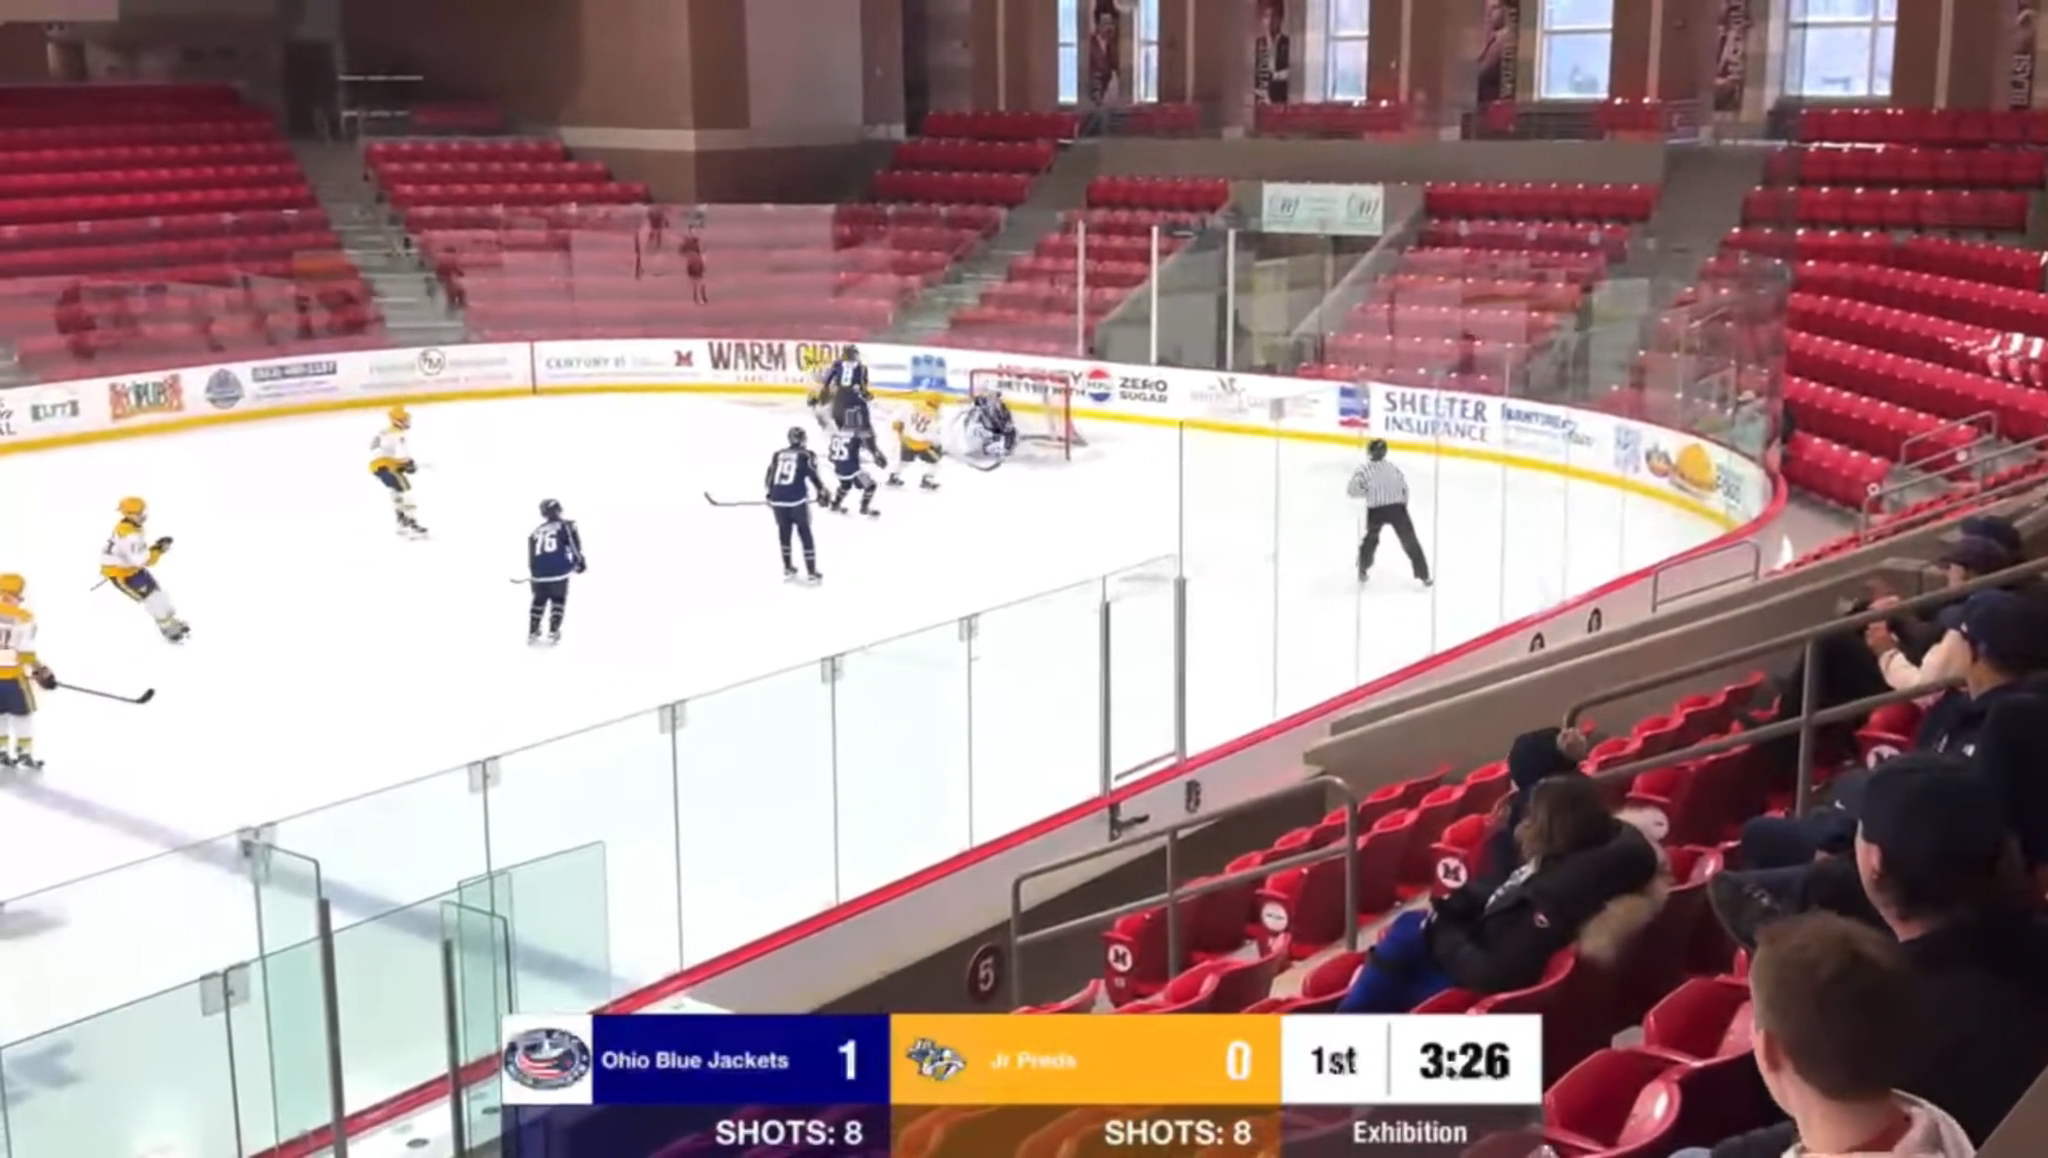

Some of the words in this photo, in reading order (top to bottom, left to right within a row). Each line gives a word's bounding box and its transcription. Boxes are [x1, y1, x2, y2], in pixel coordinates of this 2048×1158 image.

[708, 341, 787, 372] WARM
[1119, 377, 1168, 392] ZERO
[1119, 391, 1168, 404] SUGAR
[1384, 391, 1488, 423] SHELTER
[1384, 416, 1488, 443] INSURANCE
[831, 436, 849, 461] 95
[774, 459, 797, 485] 19
[533, 530, 558, 556] 76
[979, 956, 995, 991] 5
